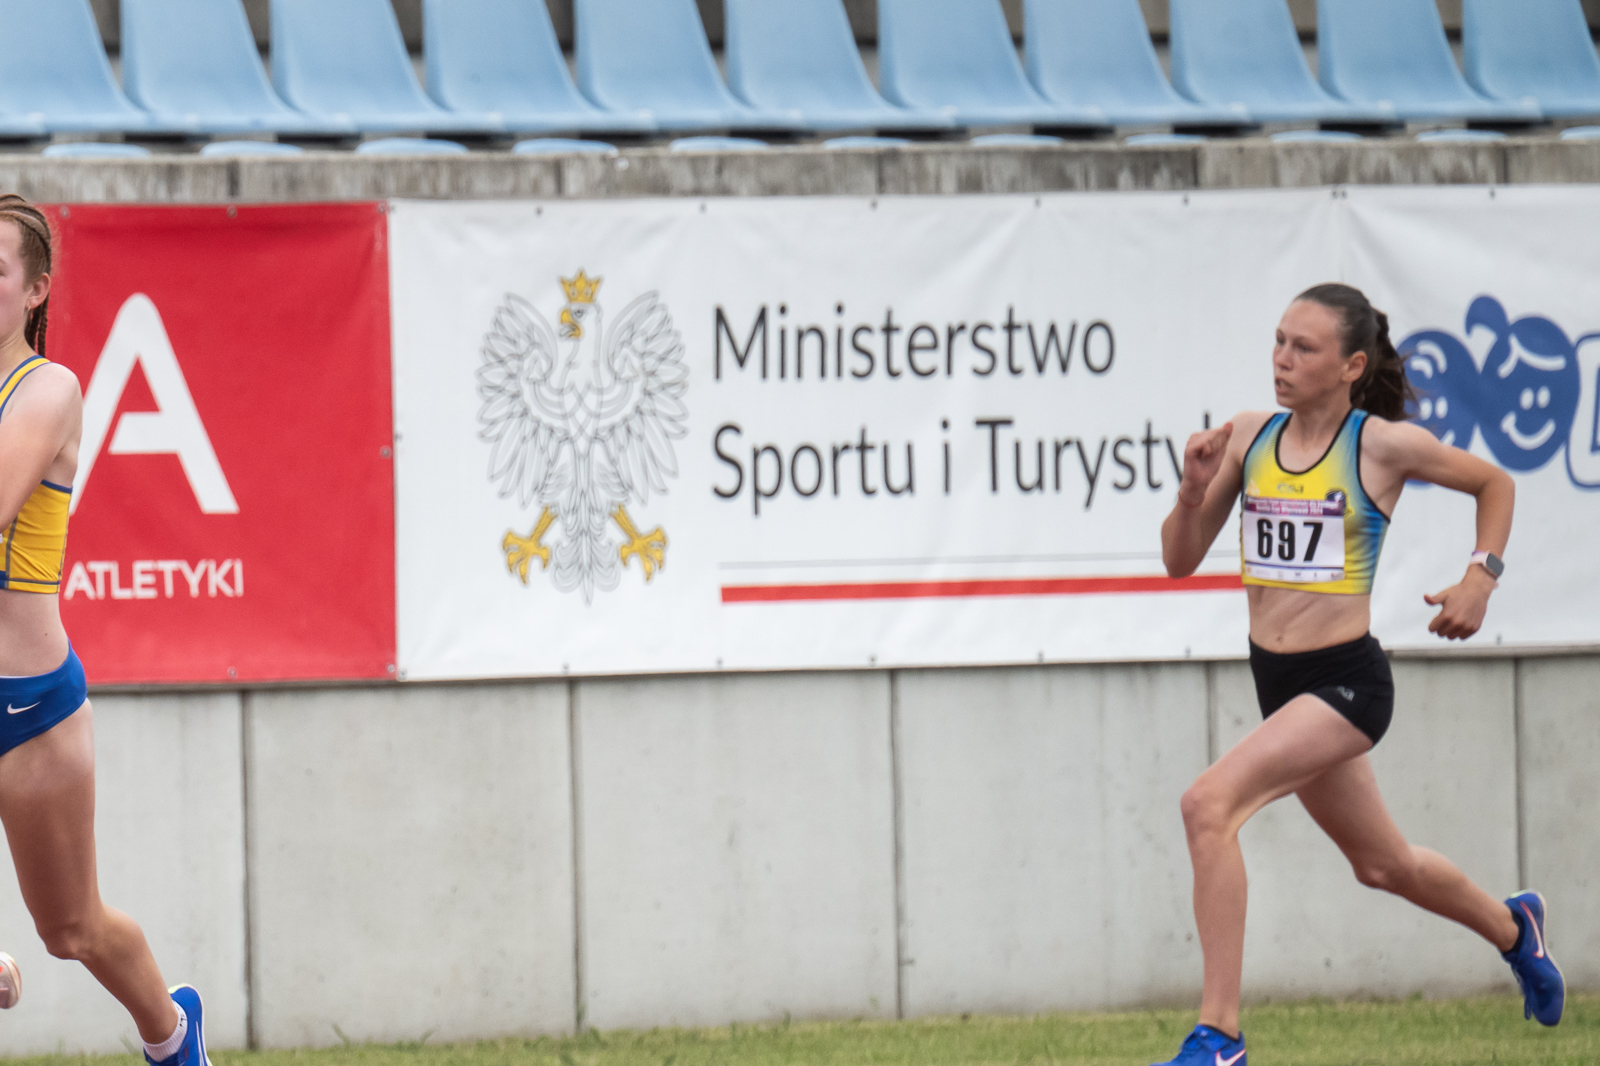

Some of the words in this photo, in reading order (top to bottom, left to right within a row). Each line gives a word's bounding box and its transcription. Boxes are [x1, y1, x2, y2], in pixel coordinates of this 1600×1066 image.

[712, 302, 1117, 382] Ministerstwo
[712, 422, 916, 517] Sportu
[940, 417, 953, 495] i
[1257, 517, 1323, 563] 697
[63, 557, 245, 601] ATLETYKI
